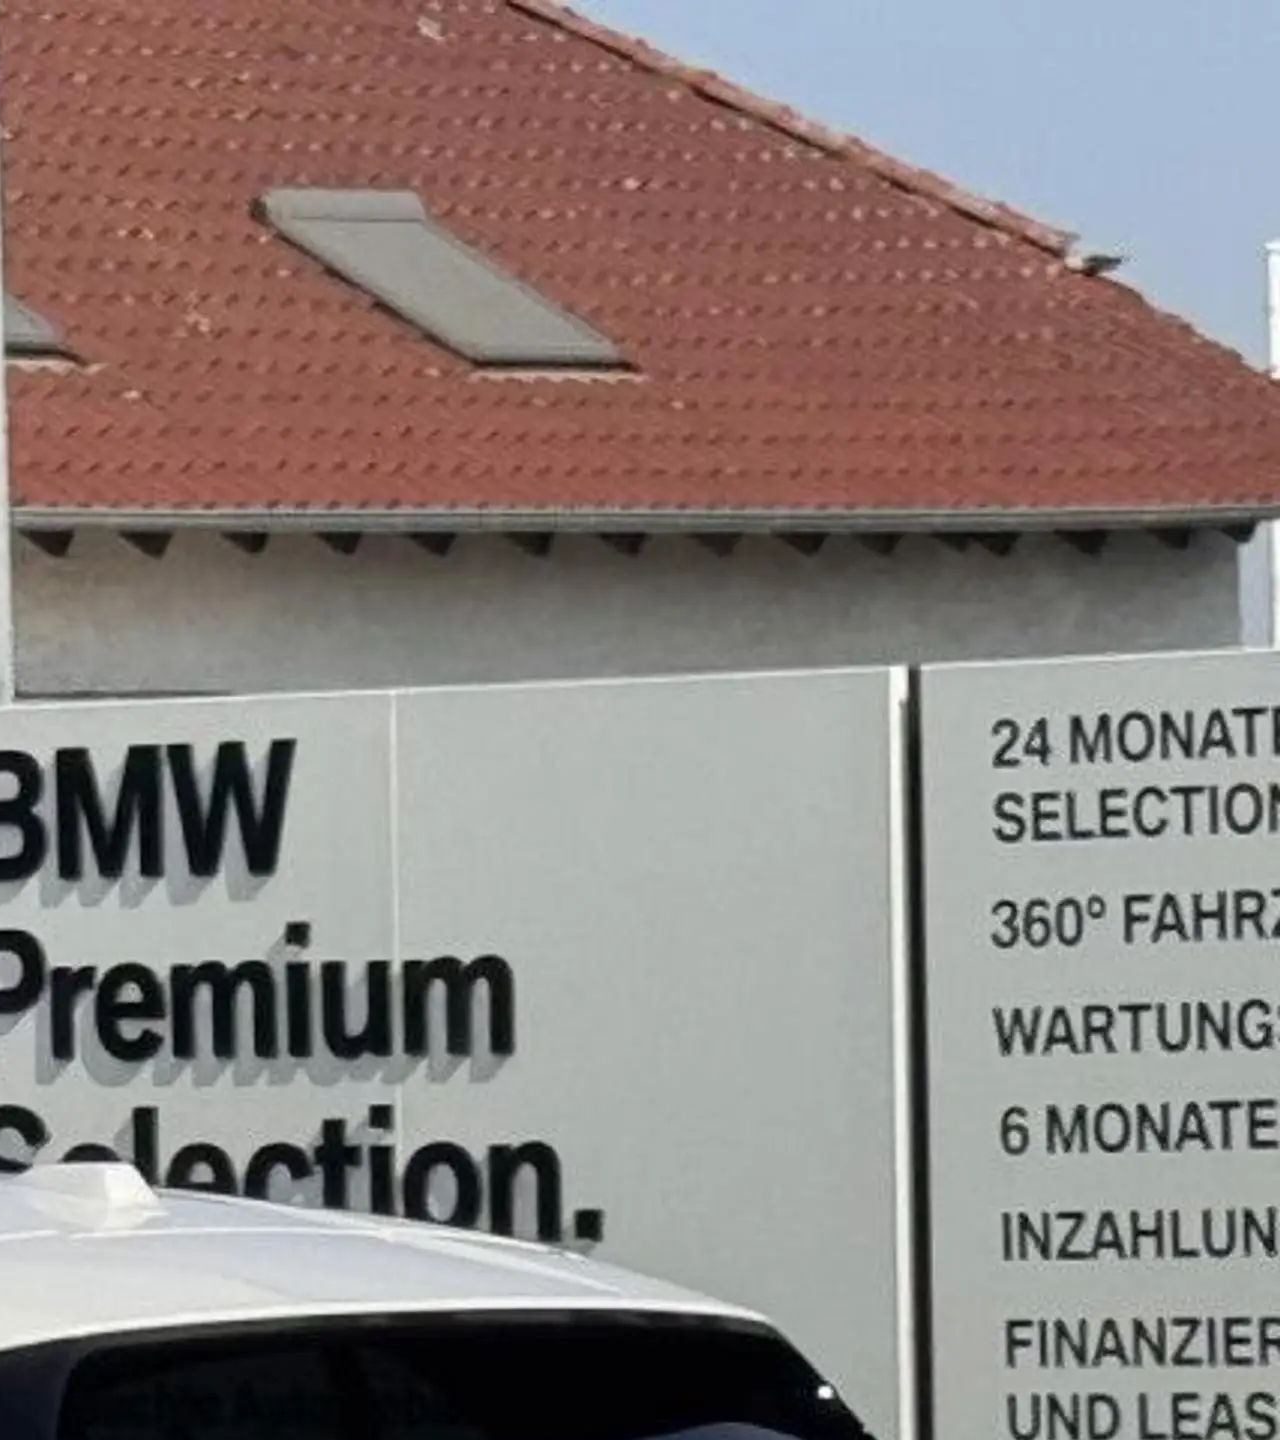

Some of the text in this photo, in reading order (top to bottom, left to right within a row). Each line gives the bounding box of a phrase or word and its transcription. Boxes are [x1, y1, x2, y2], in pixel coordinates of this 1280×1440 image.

[991, 717, 1052, 768] 24
[991, 894, 1107, 949] 360°
[992, 998, 1280, 1058] WARTUNG
[1000, 1098, 1280, 1156] 6 MONATE
[1001, 1207, 1279, 1262] INZAHLUN
[1005, 1316, 1280, 1370] FINANZIER
